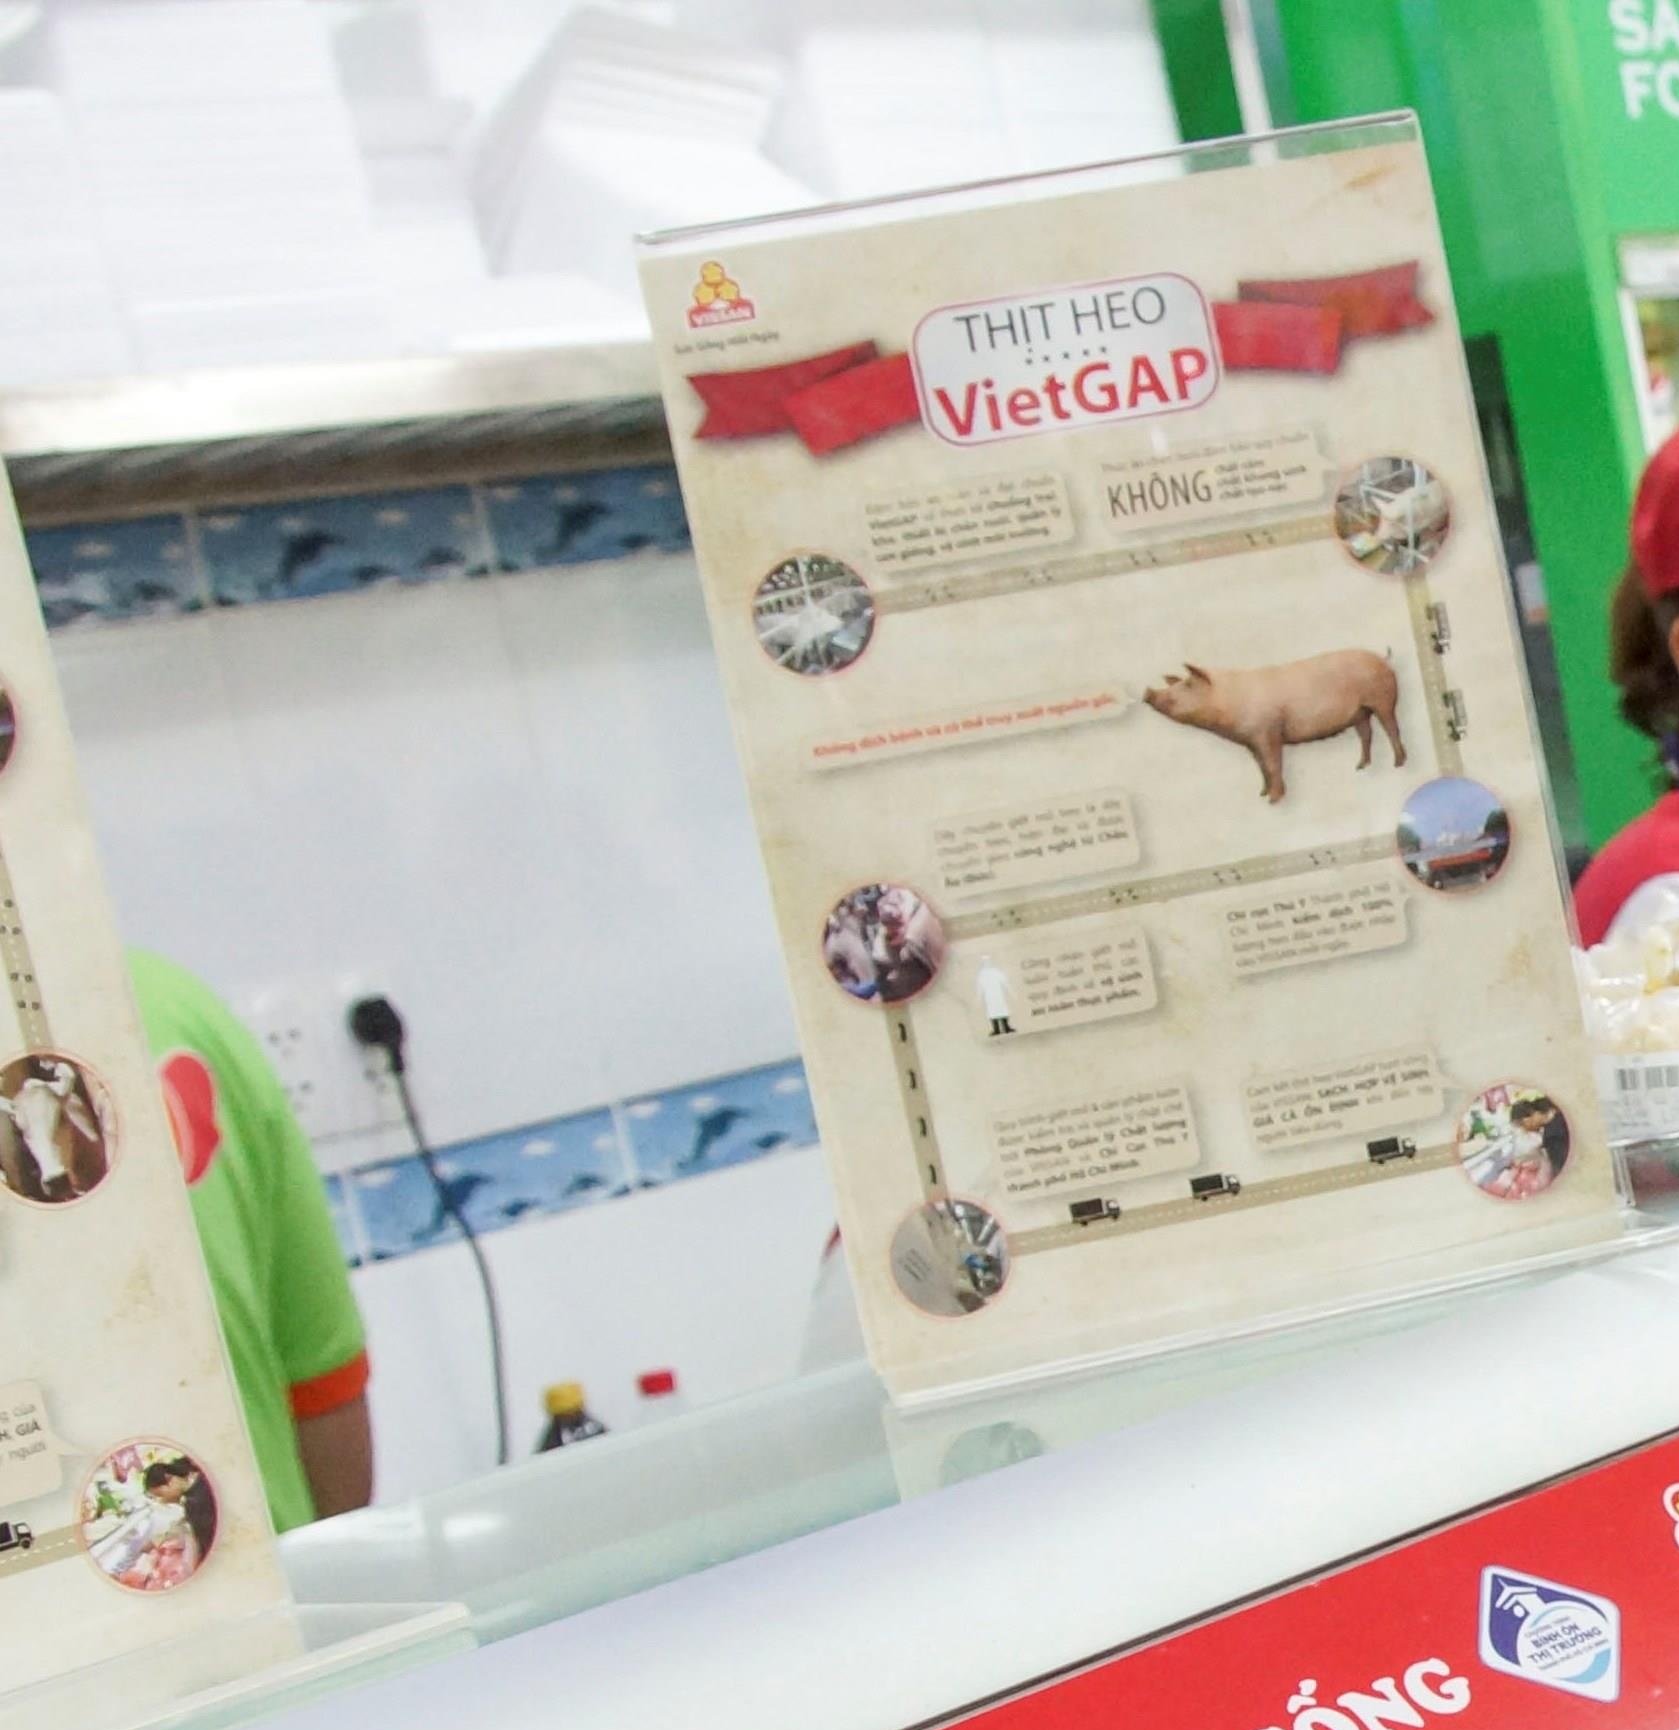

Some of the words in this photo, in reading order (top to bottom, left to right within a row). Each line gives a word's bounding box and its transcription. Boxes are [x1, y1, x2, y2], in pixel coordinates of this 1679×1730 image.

[1070, 285, 1167, 336] HEO
[933, 346, 1209, 437] VietGAP
[1105, 468, 1213, 518] KHÔNG
